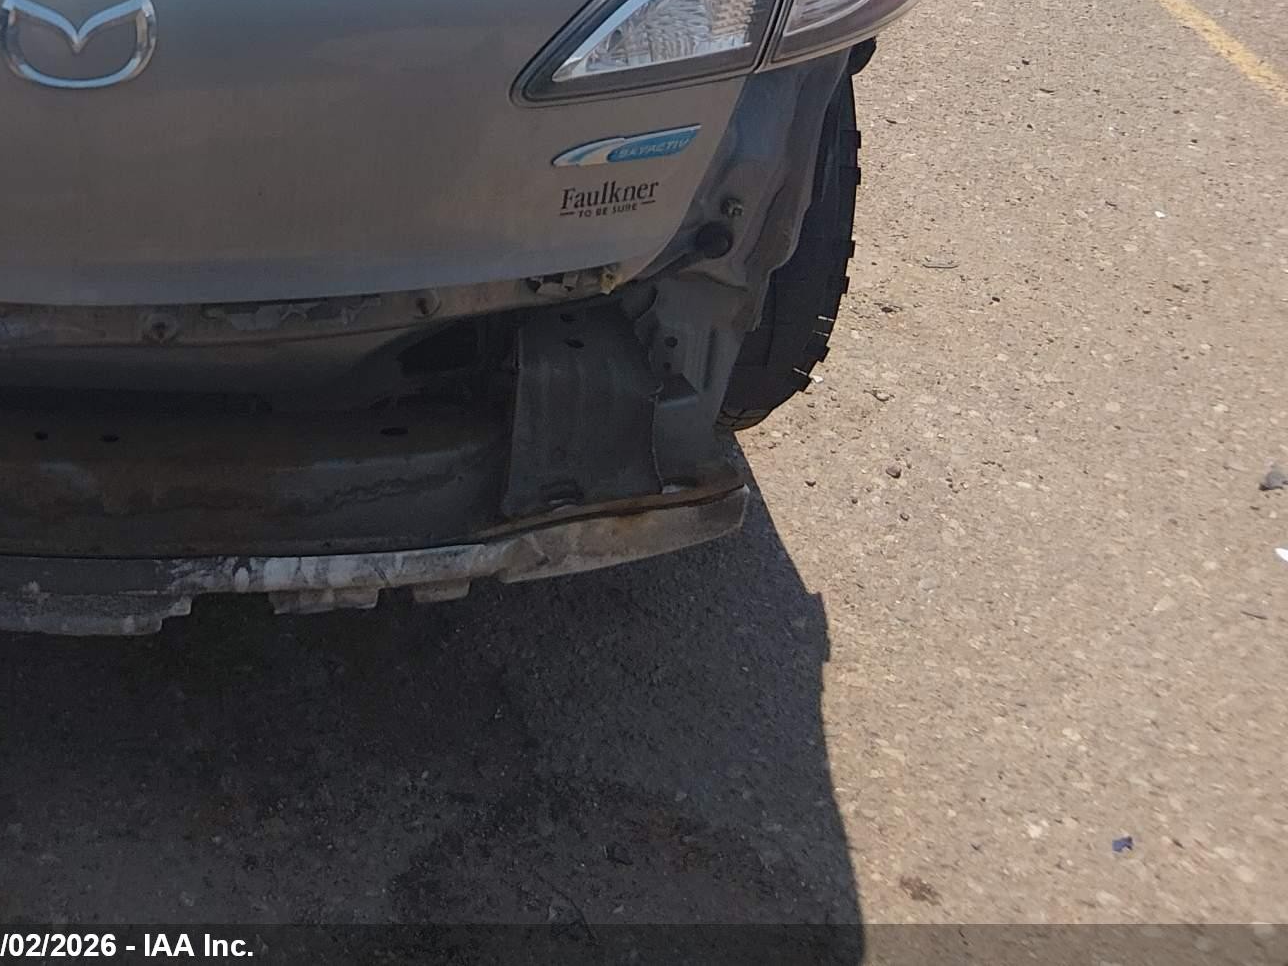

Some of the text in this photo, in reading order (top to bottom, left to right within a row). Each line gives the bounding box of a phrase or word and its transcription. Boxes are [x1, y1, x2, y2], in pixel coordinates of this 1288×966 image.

[560, 181, 660, 210] Faulkner
[578, 203, 638, 218] TO BE SURE
